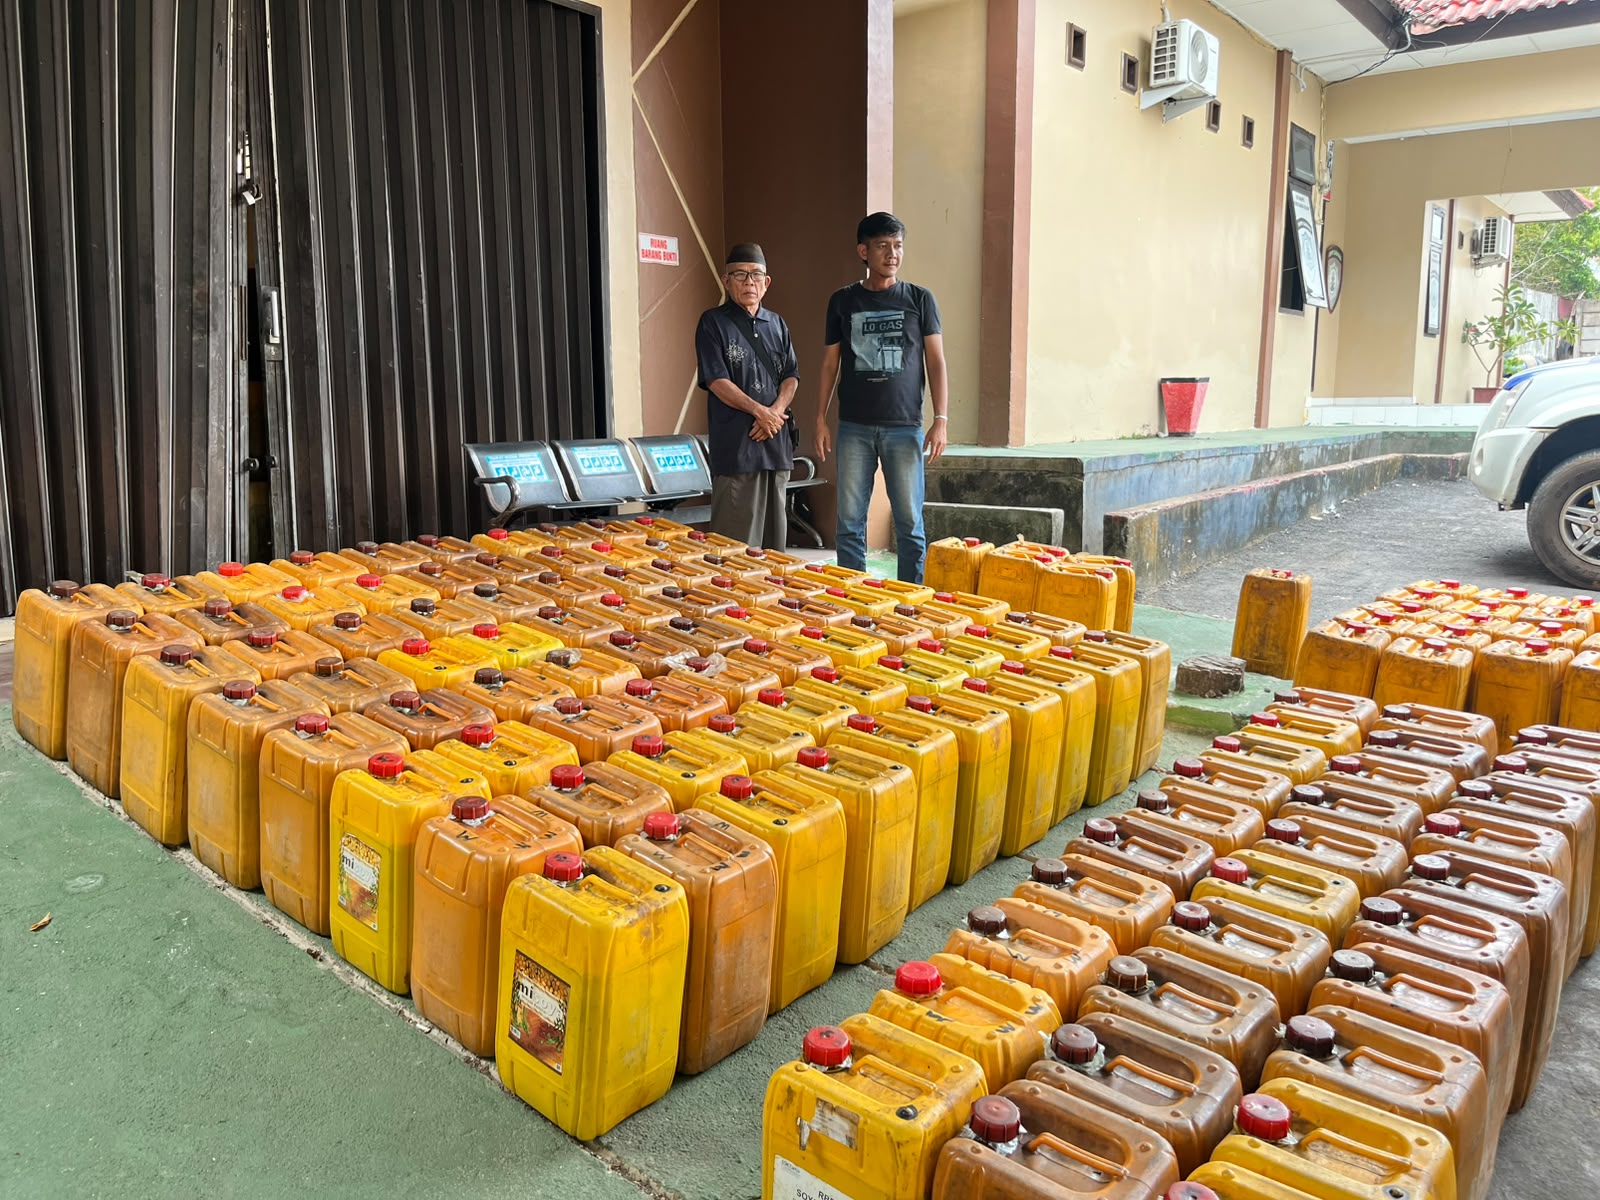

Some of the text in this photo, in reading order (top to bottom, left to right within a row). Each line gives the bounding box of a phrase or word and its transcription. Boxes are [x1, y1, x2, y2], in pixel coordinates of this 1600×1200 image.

[650, 238, 668, 250] RUANG
[641, 248, 678, 262] BARANG BUKTI
[879, 320, 903, 332] GAS
